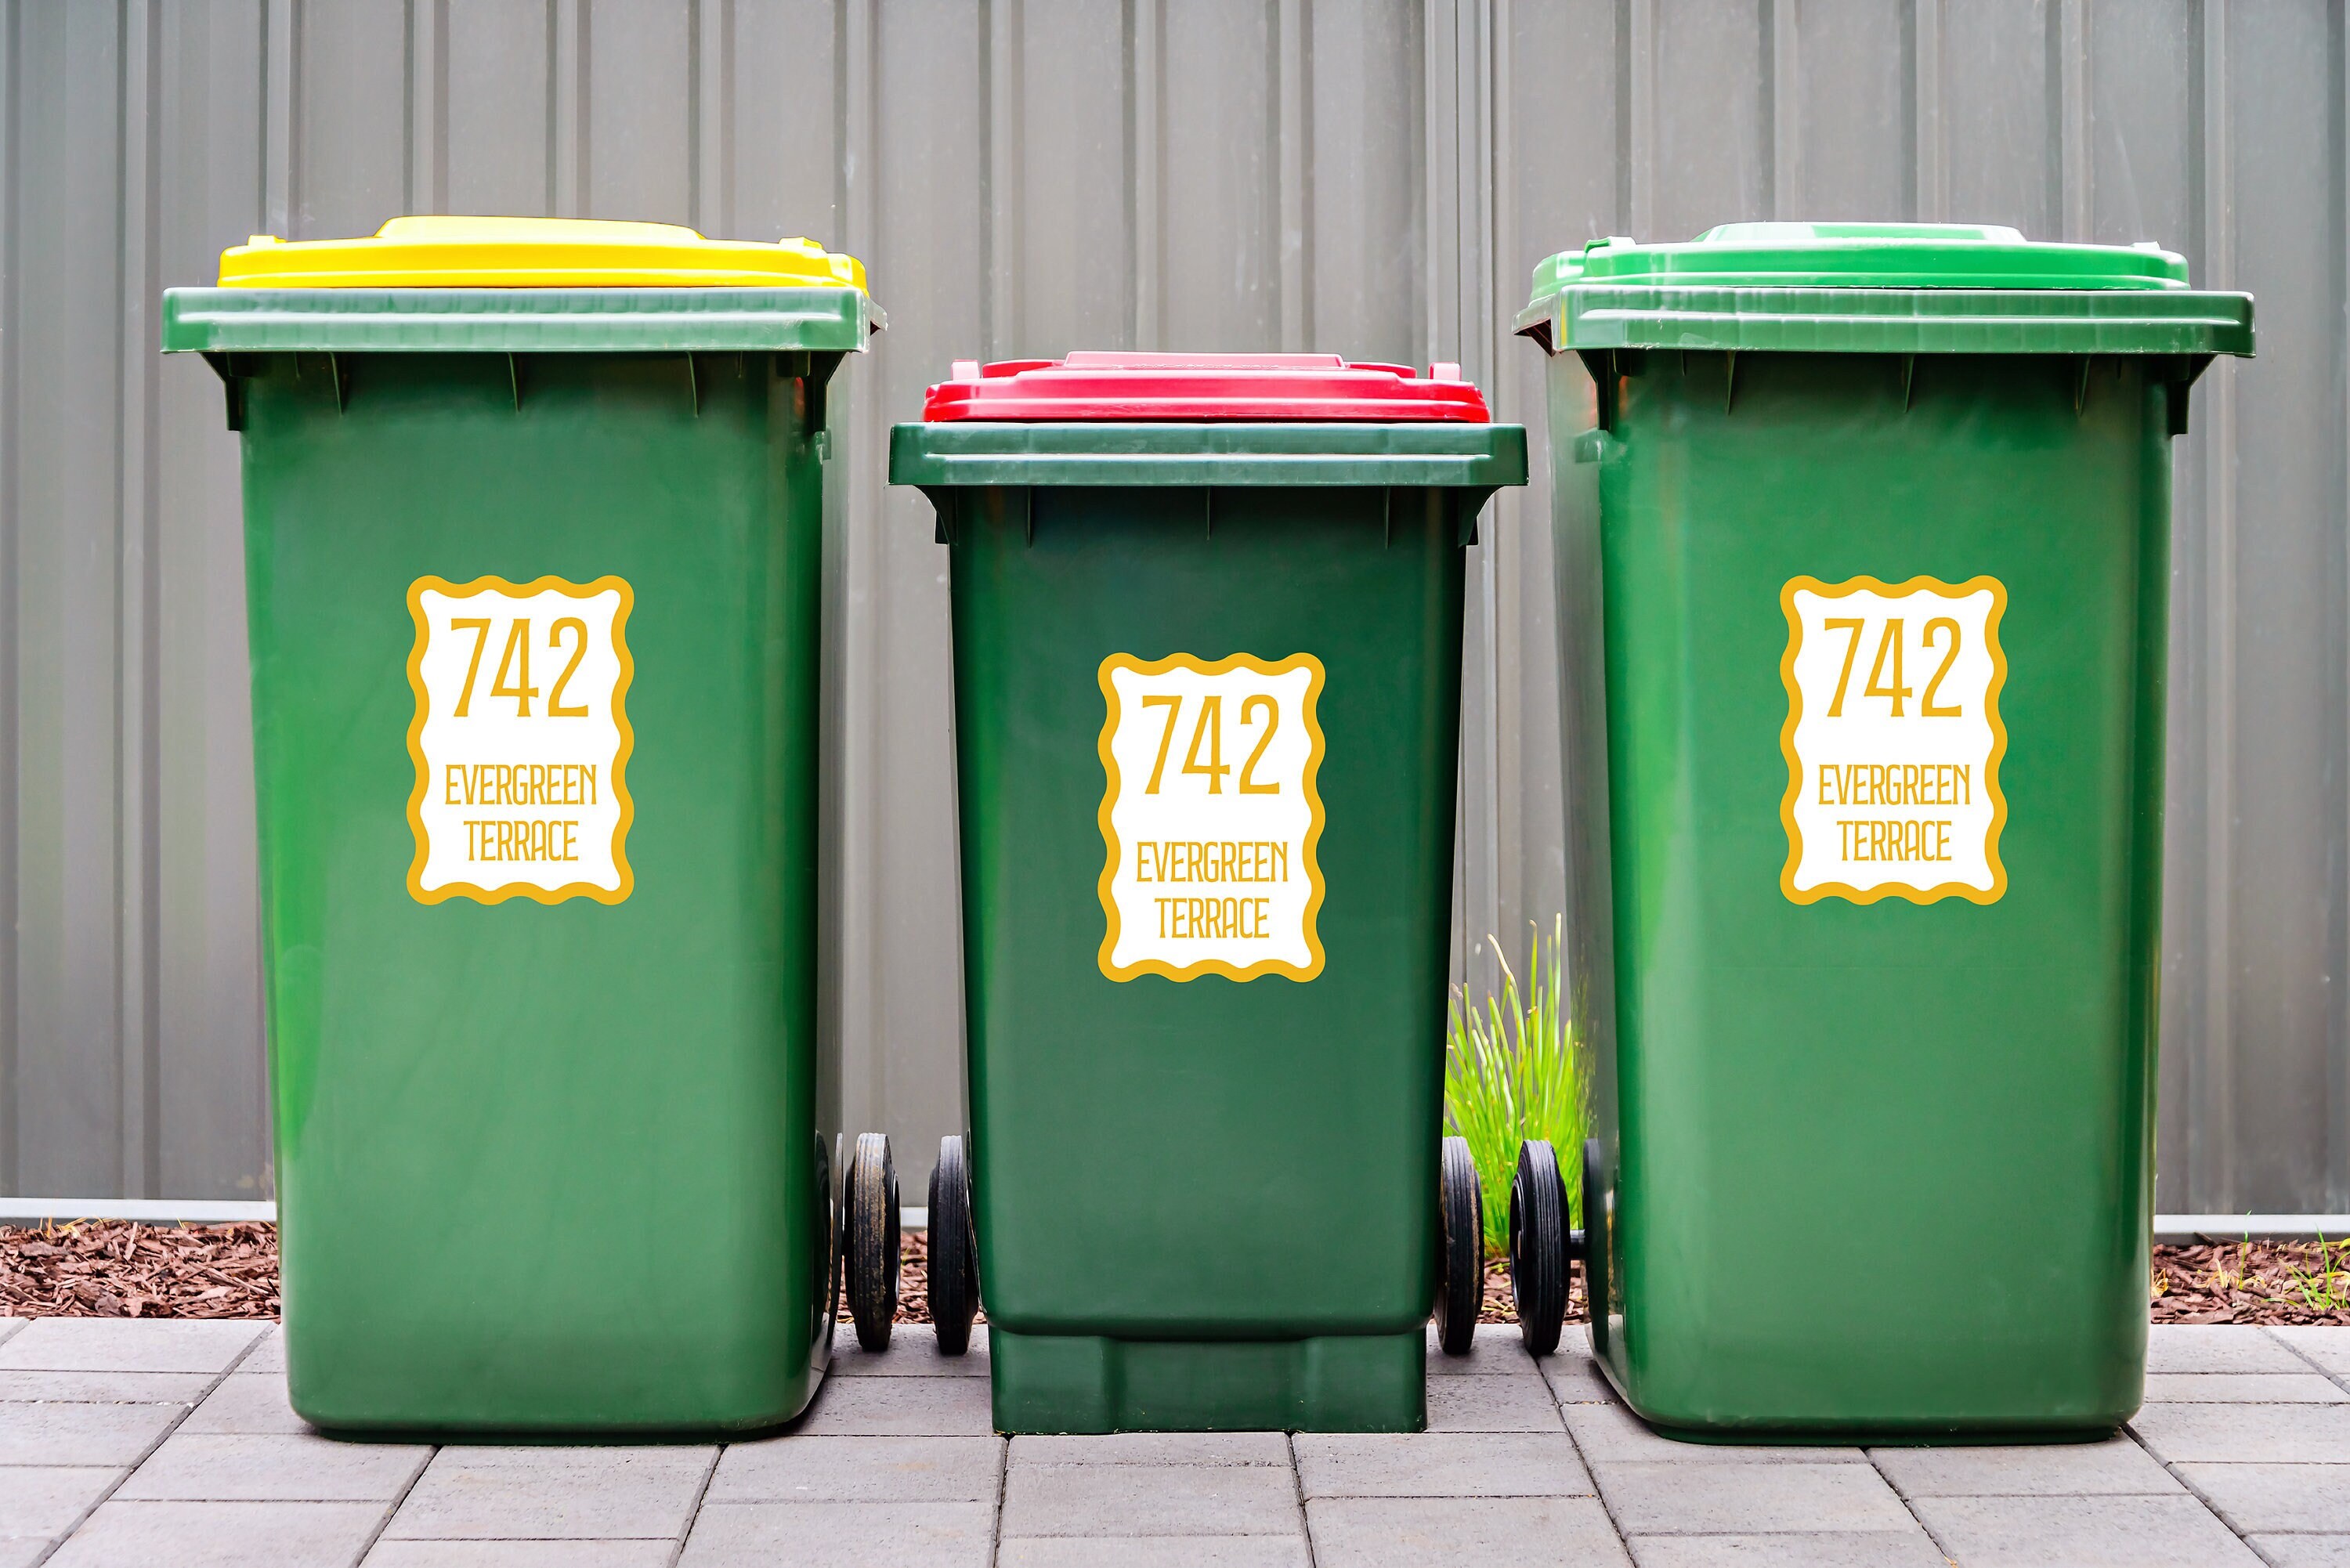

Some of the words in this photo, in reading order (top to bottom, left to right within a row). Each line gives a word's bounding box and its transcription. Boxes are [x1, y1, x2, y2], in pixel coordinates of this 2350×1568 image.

[451, 616, 588, 717] 742
[1824, 616, 1961, 717] 742
[1142, 694, 1280, 795] 742
[445, 764, 597, 806] EVERGREEN
[1819, 764, 1970, 806] EVERGREEN
[464, 819, 579, 862] TERRACE
[1137, 841, 1288, 883] EVERGREEN
[1836, 819, 1952, 862] TERRACE
[1154, 897, 1270, 939] TERRACE
